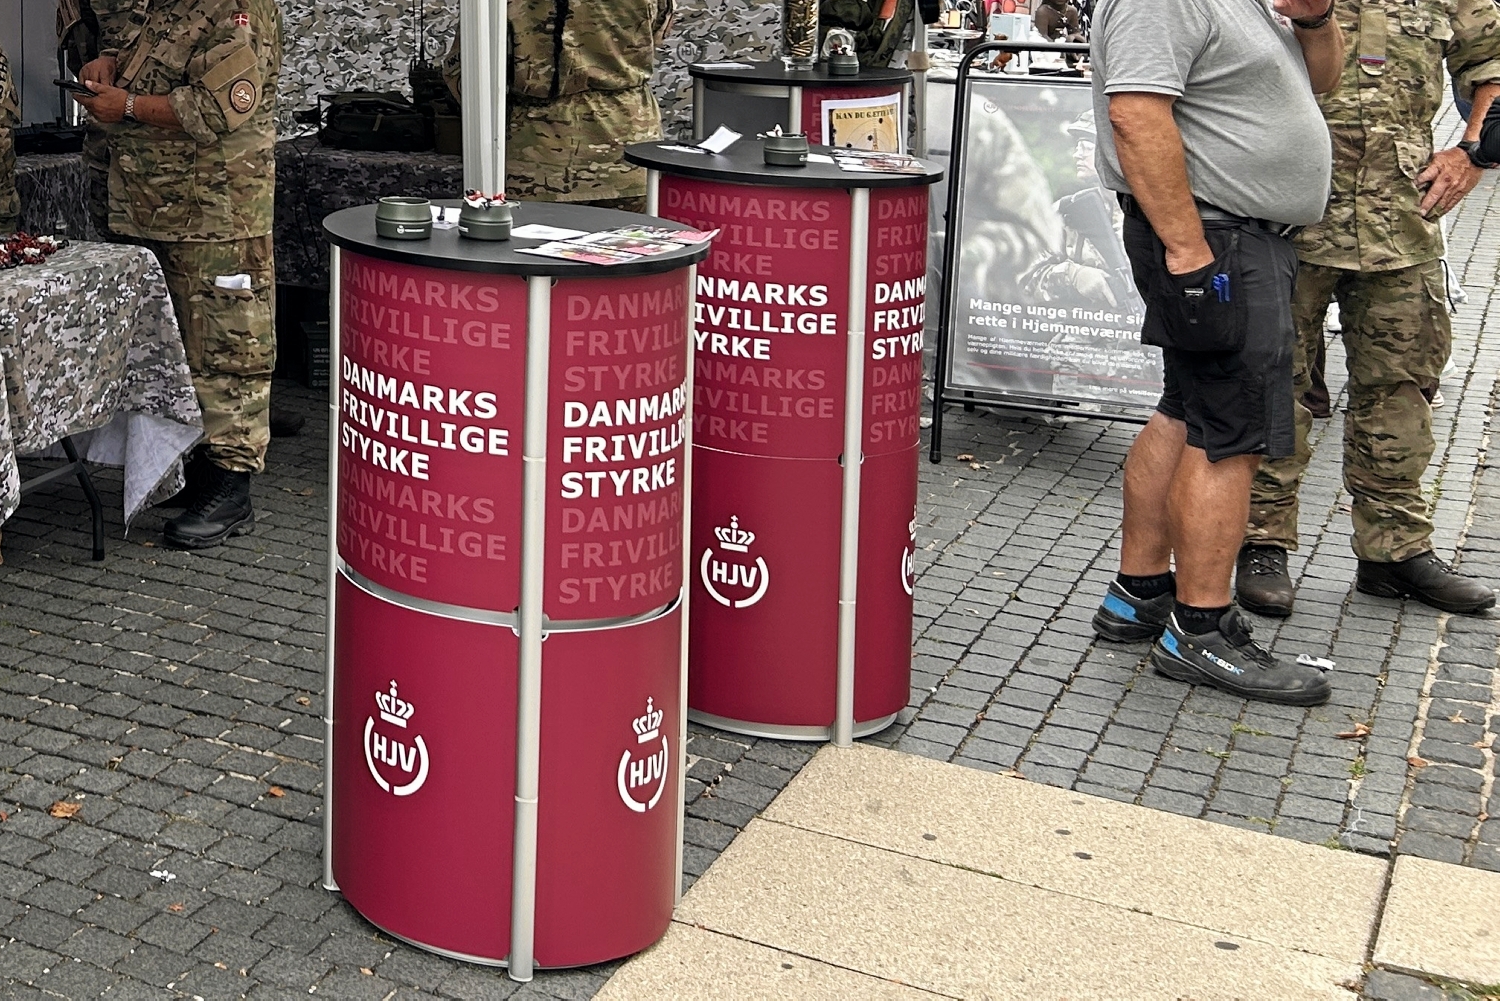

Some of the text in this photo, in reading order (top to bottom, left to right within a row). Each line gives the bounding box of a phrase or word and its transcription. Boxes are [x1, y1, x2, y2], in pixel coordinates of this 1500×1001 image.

[835, 111, 853, 120] KAN
[854, 111, 865, 119] DU
[667, 187, 830, 222] DANMARKS
[342, 258, 499, 312] DANMARKS
[342, 289, 511, 349] FRIVILLIGE
[968, 314, 1007, 329] rette
[1011, 317, 1017, 329] i
[969, 298, 1022, 315] Mange
[1026, 305, 1067, 319] unge
[1072, 307, 1122, 323] finder
[342, 323, 431, 376] STYRKE
[343, 354, 498, 419] DANMARKS
[563, 354, 677, 392] STYRKE
[343, 387, 510, 456] FRIVILLIGE
[342, 420, 430, 480] STYRKE
[341, 455, 495, 524] DANMARKS
[560, 457, 676, 499] STYRKE
[341, 486, 507, 561] FRIVILLIGE
[340, 522, 428, 584] STYRKE
[712, 559, 758, 588] HJV
[559, 561, 673, 605] STYRKE
[373, 731, 417, 773] HJV
[630, 749, 664, 789] HJV
